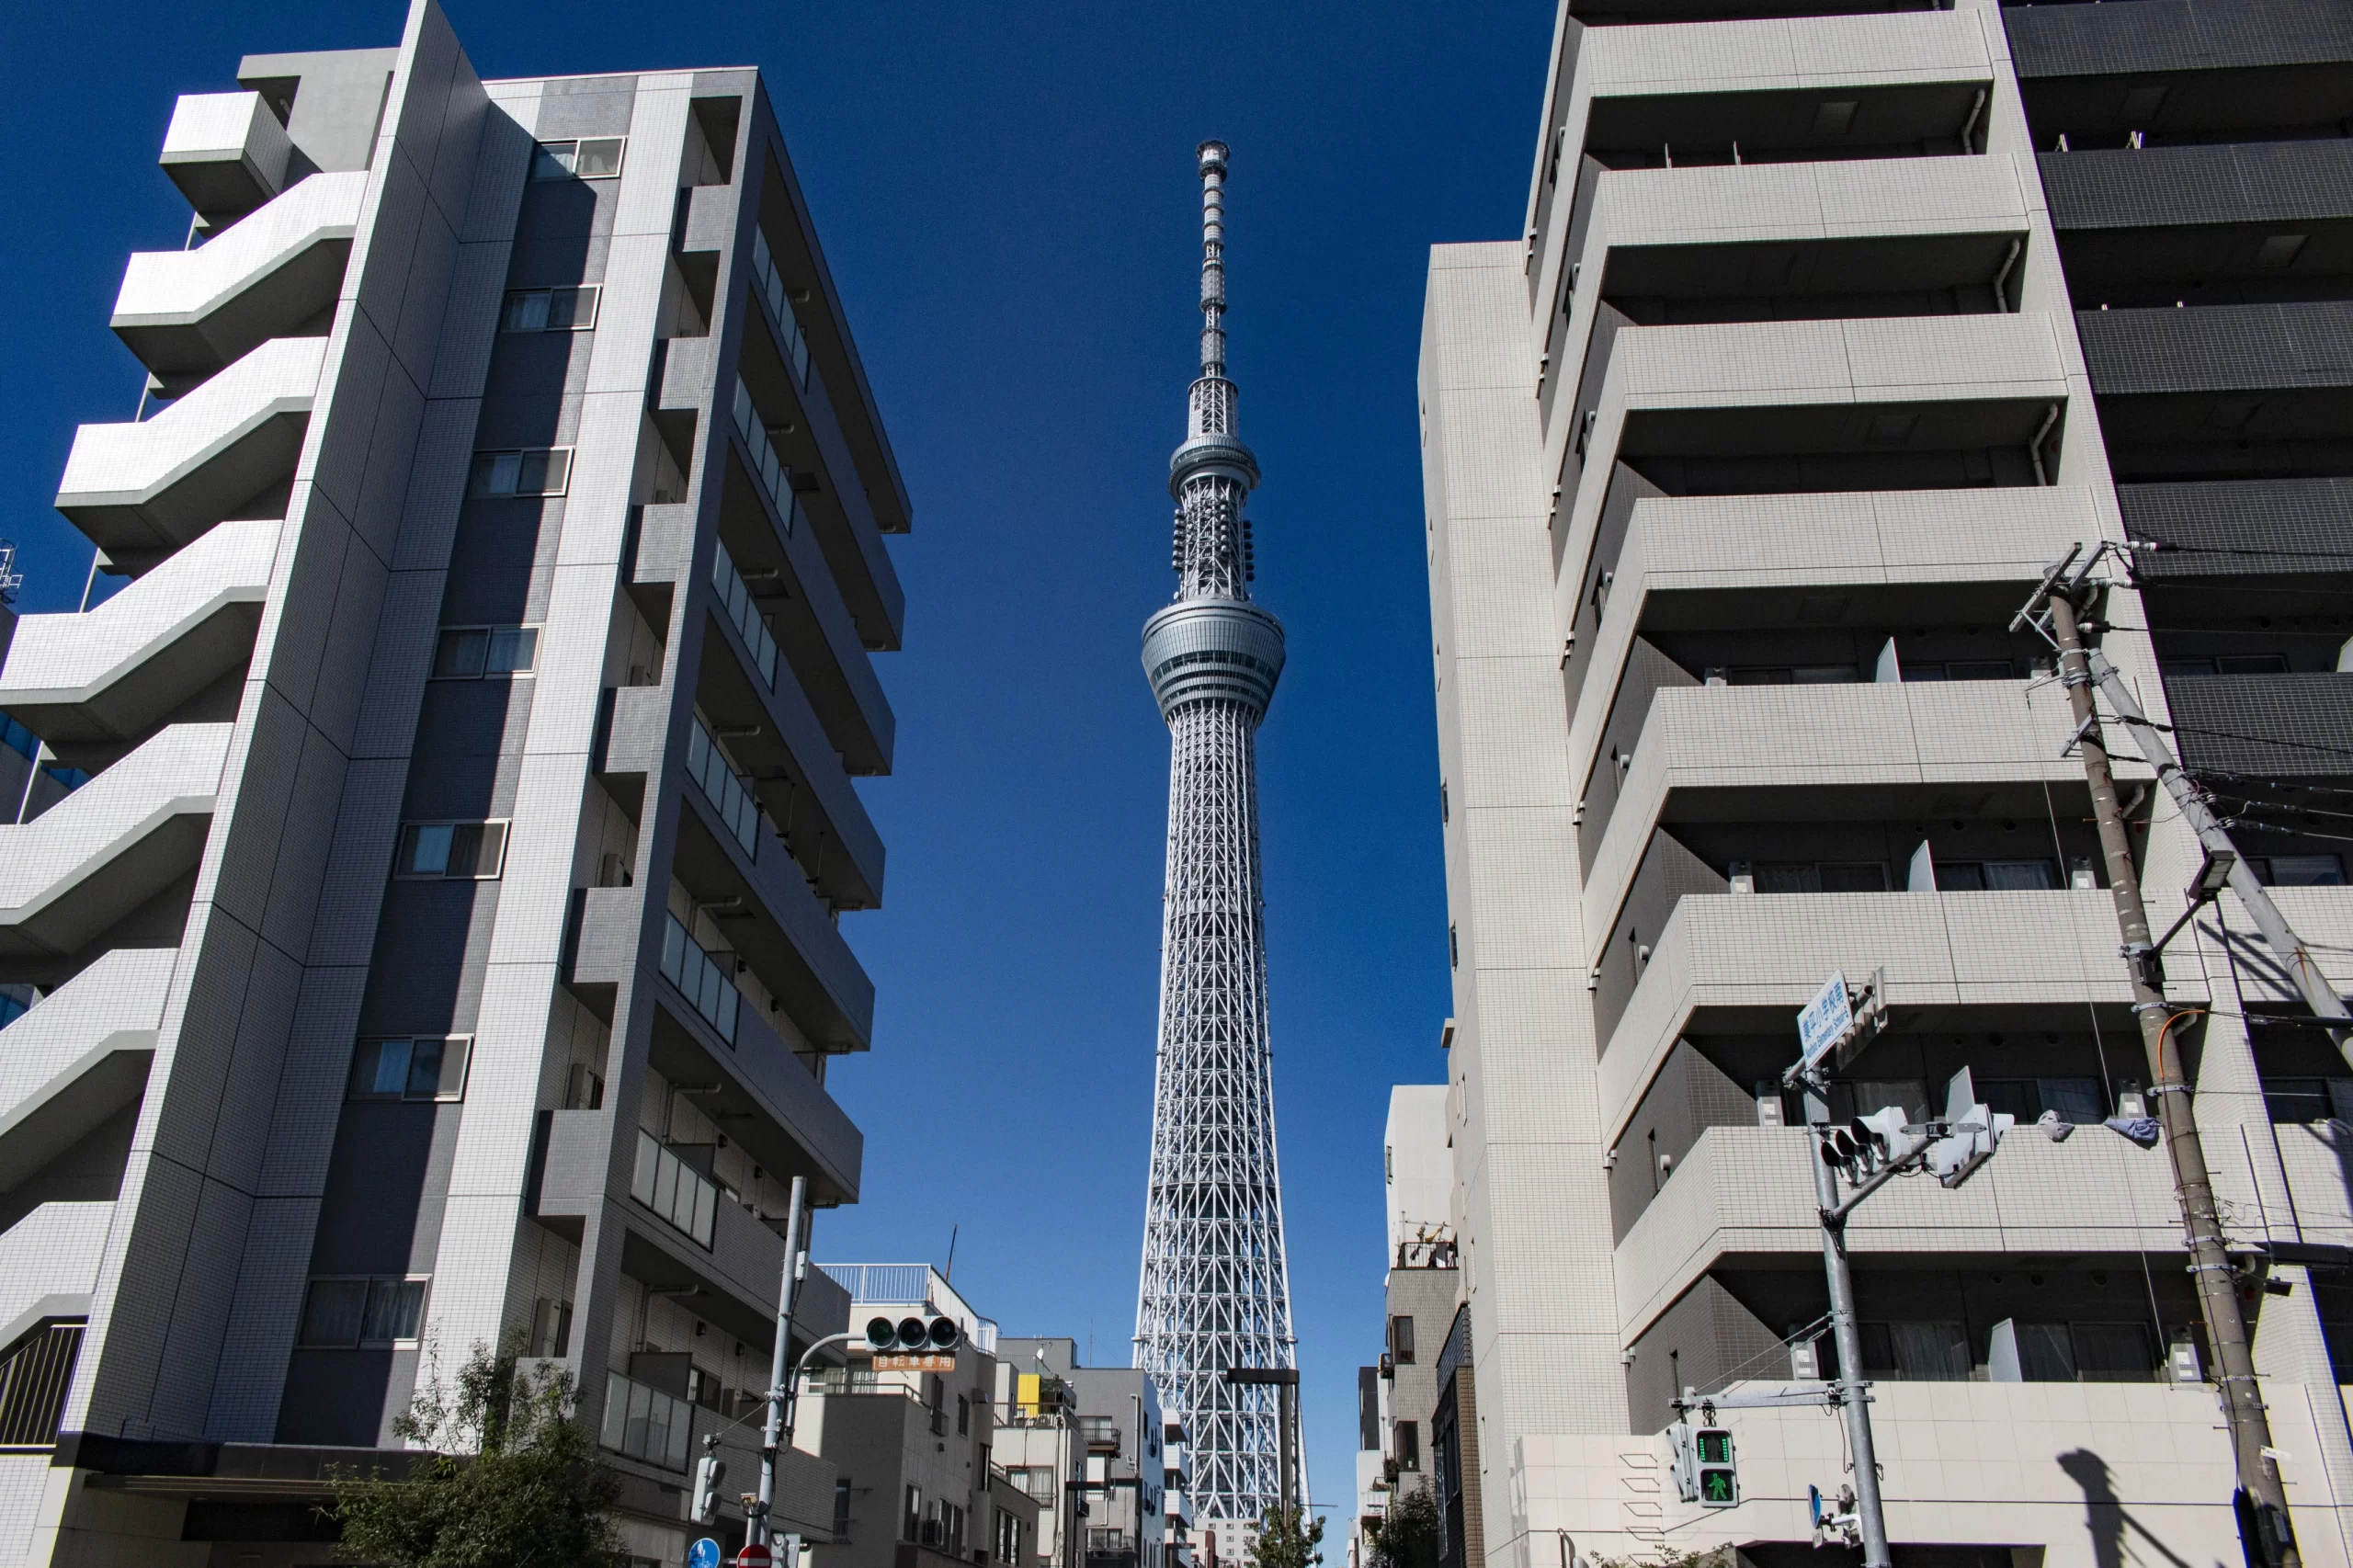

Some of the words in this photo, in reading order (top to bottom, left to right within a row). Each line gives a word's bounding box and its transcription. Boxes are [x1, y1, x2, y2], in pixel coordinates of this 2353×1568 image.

[878, 1355, 951, 1369] 自転車専用
